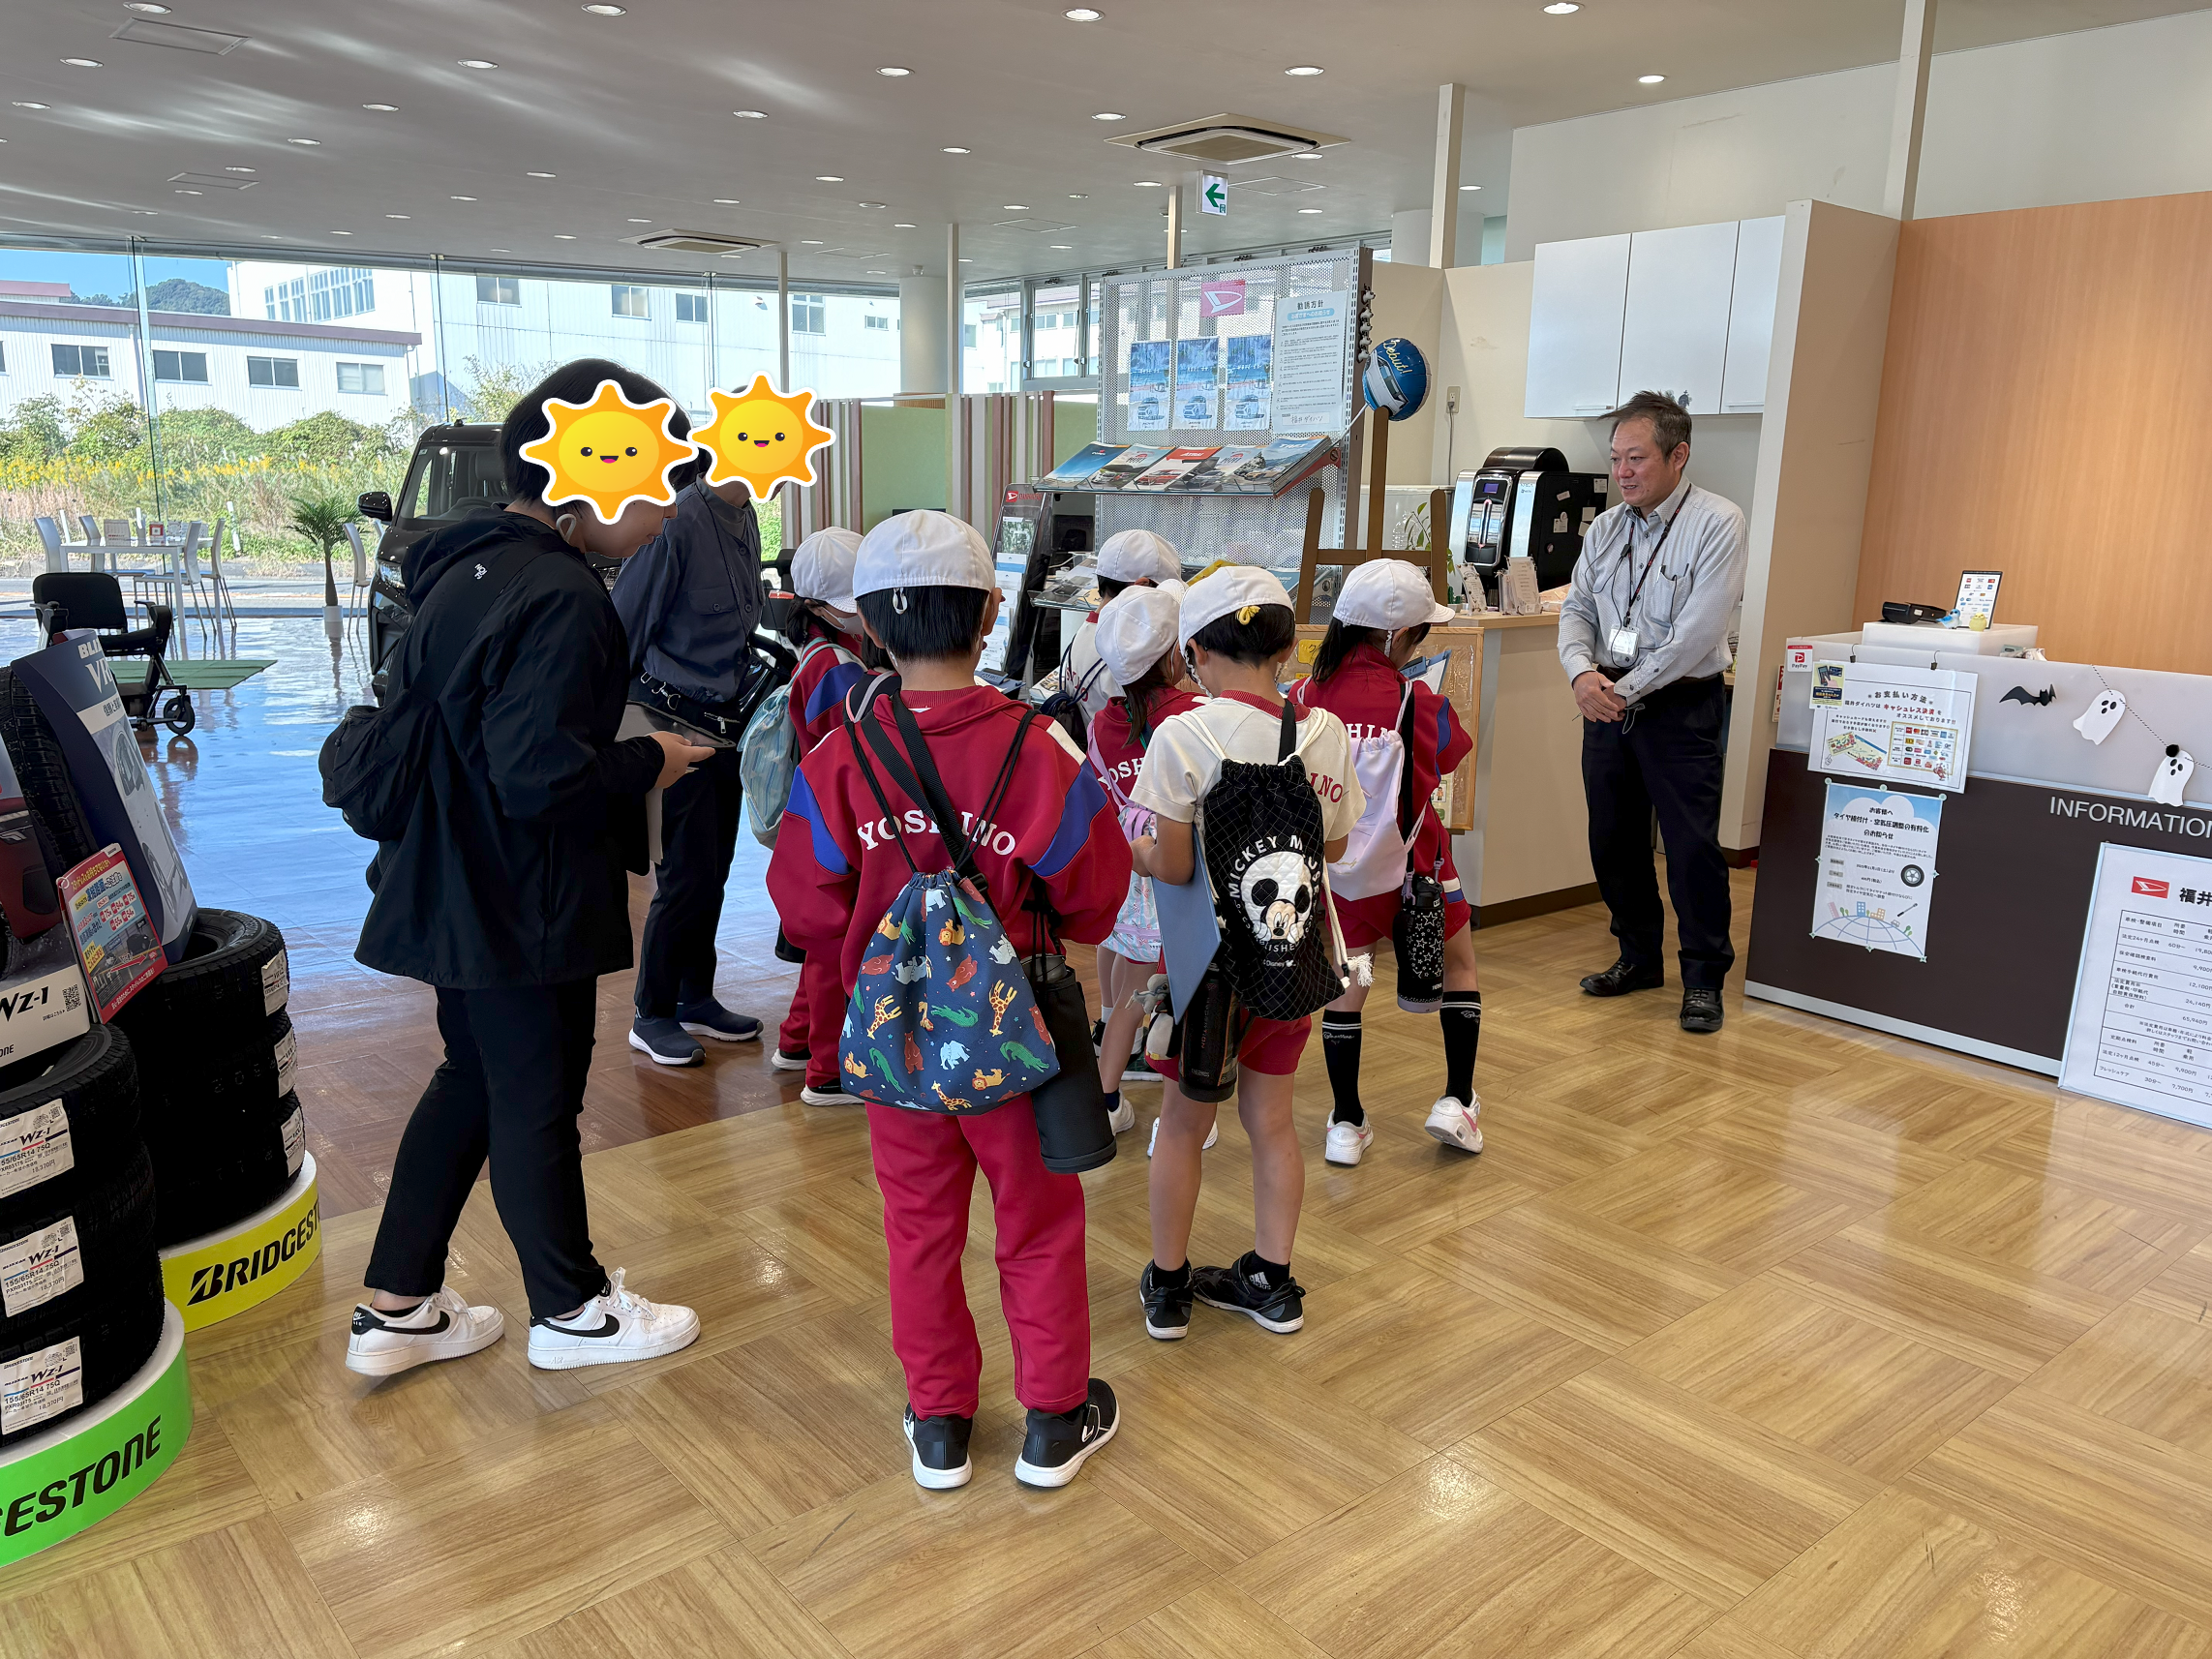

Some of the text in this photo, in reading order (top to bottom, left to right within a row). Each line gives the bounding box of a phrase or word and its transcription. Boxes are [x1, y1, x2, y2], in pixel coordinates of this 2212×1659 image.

[1297, 299, 1323, 310] 勧誘方針
[1383, 340, 1412, 375] Debut!
[1874, 690, 1927, 704] お支払い方法
[1869, 807, 1894, 816] お客様へ
[857, 809, 1015, 856] YOSINO
[2182, 1016, 2208, 1026] 65,940円
[37, 1142, 50, 1153] 75Q
[28, 1245, 59, 1265] WZ-1
[5, 1268, 44, 1288] 155/65R14
[45, 1260, 60, 1270] 75Q
[31, 1365, 63, 1383] WZ-1
[5, 1386, 45, 1404] 155/65R14
[46, 1379, 61, 1390] 75Q
